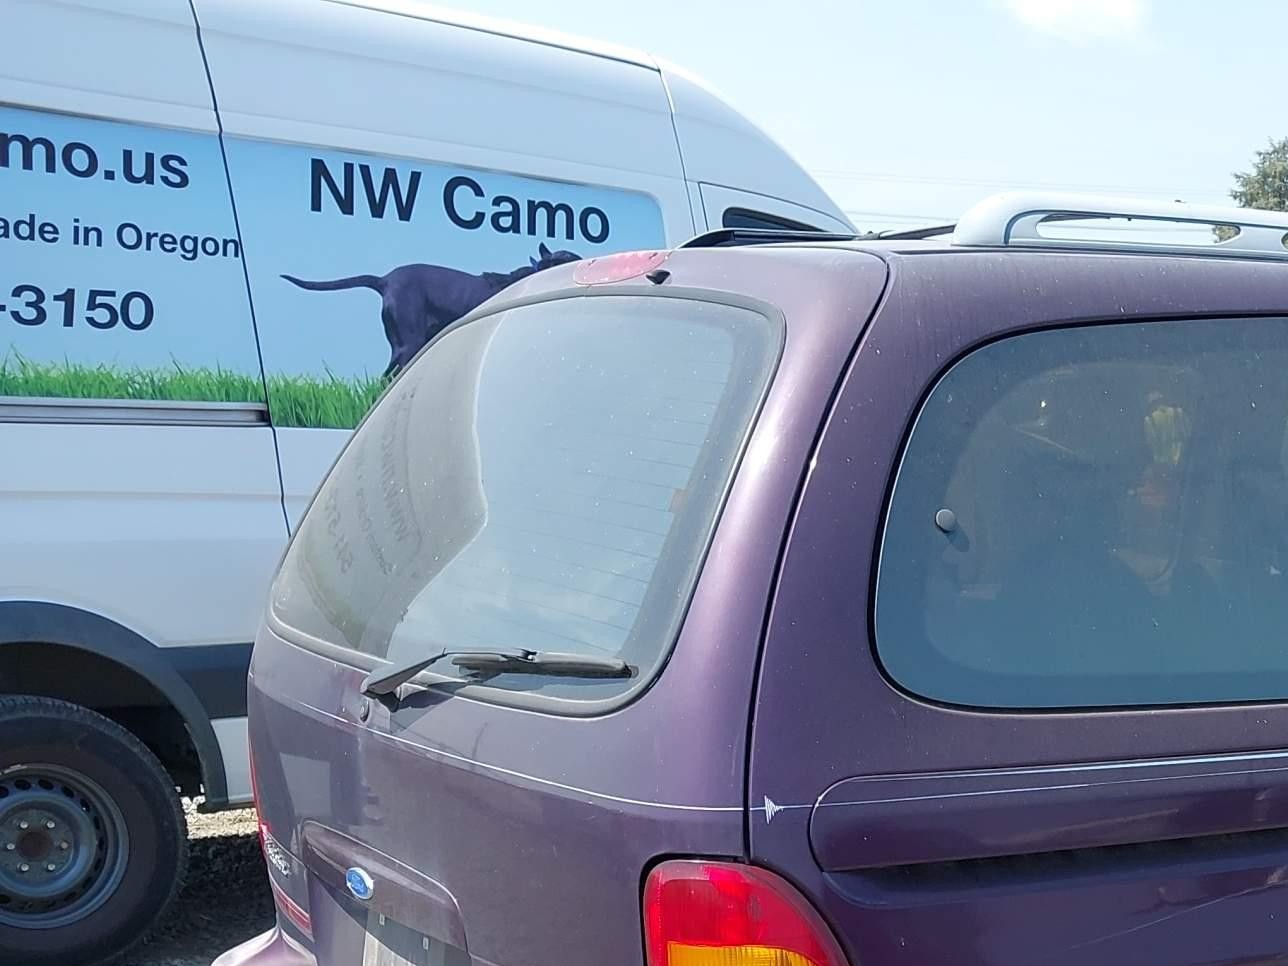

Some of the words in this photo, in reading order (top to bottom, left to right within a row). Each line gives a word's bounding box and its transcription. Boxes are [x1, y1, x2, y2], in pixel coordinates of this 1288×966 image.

[0, 133, 189, 189] mo.us
[310, 158, 422, 222] NW
[443, 175, 610, 244] Camo
[73, 218, 102, 247] in
[116, 222, 240, 261] Oregon
[0, 284, 154, 331] 3150
